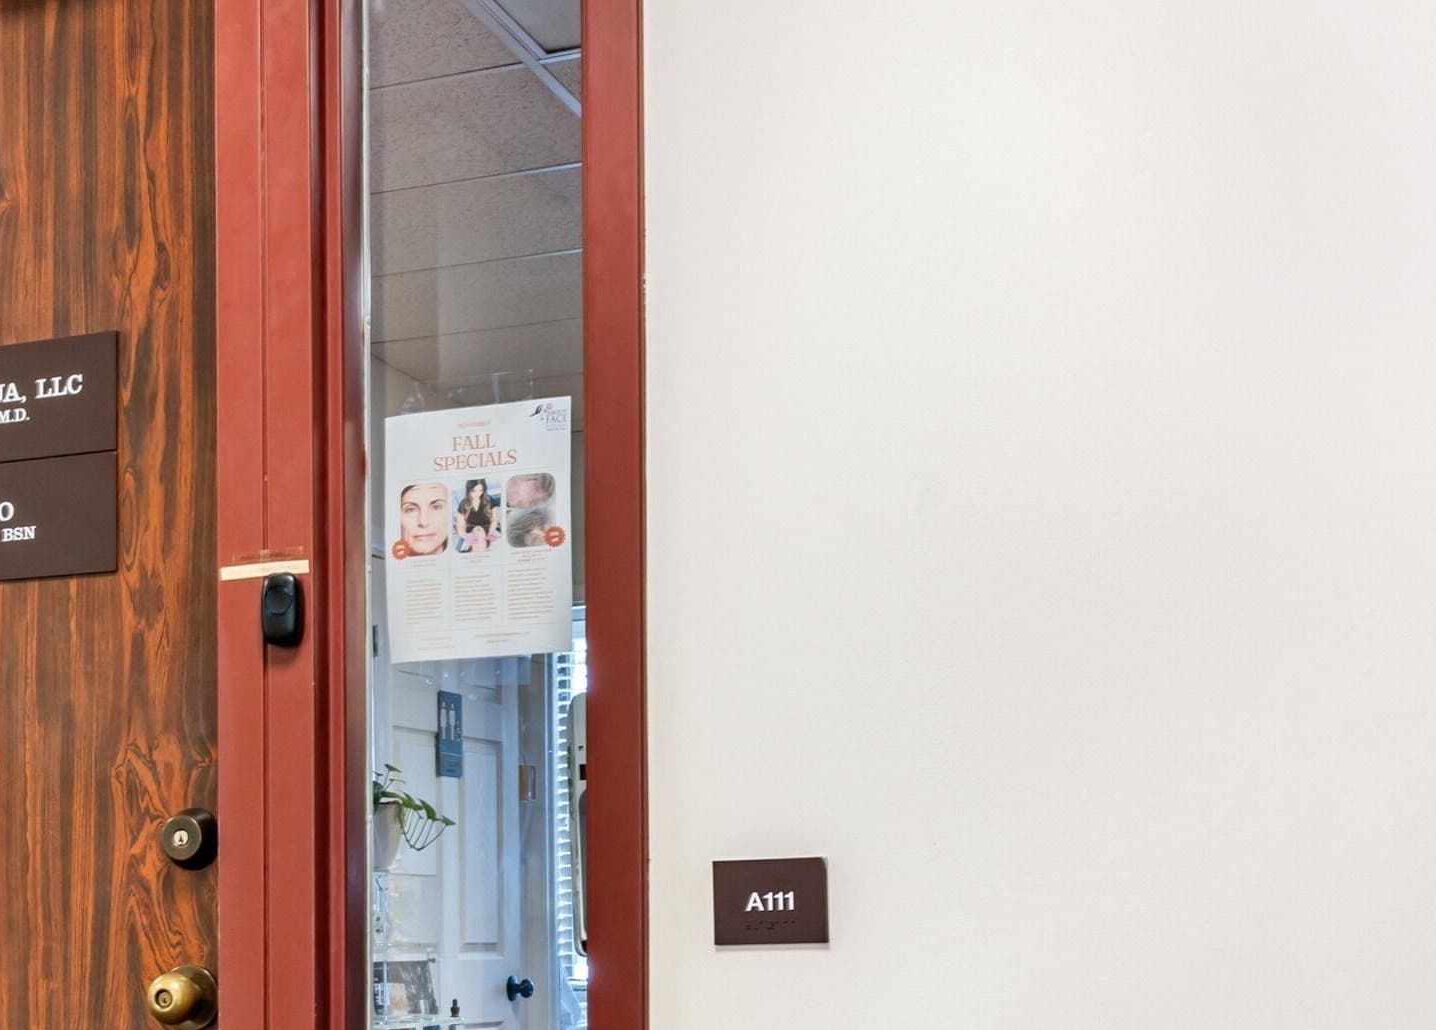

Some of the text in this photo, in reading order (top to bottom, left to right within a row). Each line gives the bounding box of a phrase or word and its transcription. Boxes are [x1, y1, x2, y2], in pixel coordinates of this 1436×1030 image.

[35, 374, 83, 399] LLC
[452, 433, 495, 452] FALL
[434, 449, 517, 472] SPECIALS
[1, 525, 37, 542] BSN
[745, 891, 795, 912] A111
